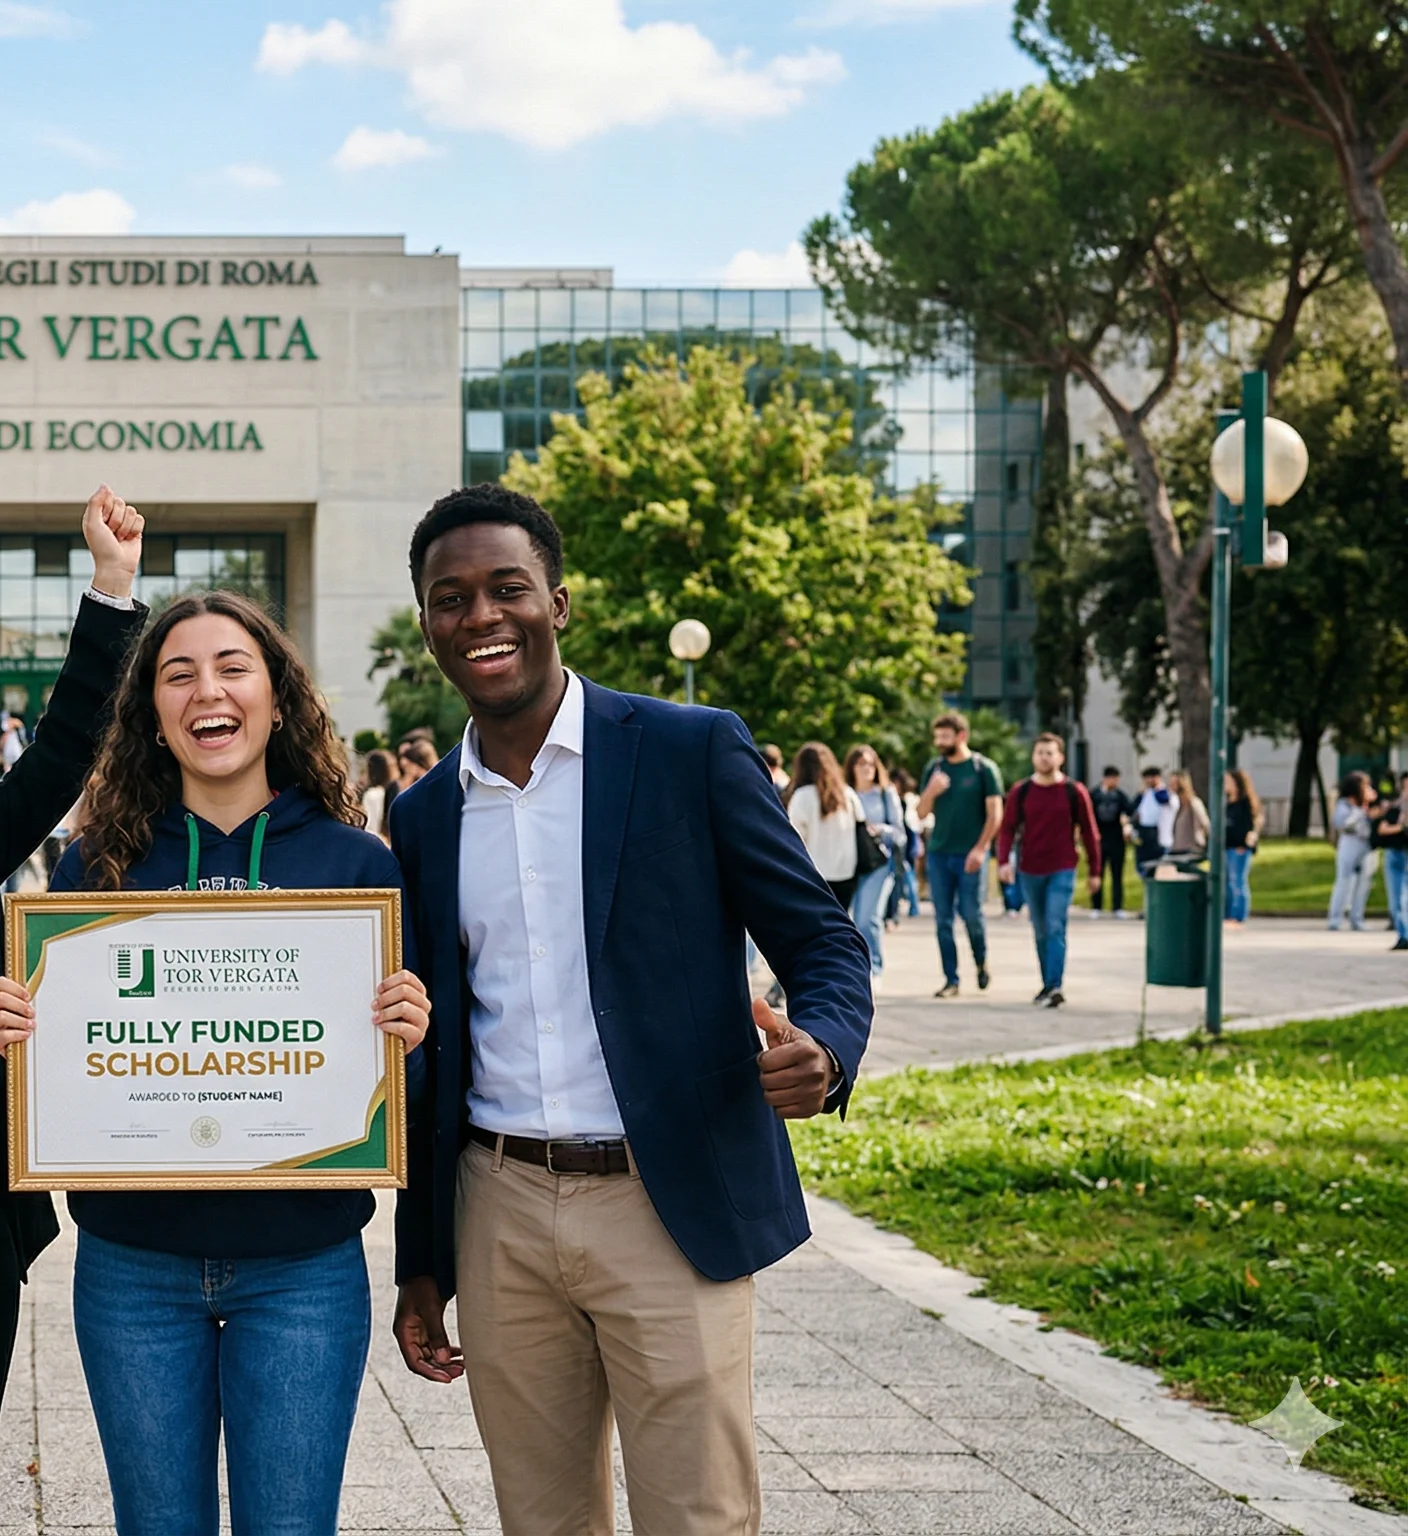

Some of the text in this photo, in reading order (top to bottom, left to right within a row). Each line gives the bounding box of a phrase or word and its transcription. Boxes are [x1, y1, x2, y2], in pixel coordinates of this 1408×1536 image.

[69, 260, 165, 286] STUDI
[176, 261, 209, 286] DI
[222, 261, 318, 286] ROMA
[42, 314, 319, 362] VERGATA
[46, 420, 264, 452] ECONOMIA
[163, 948, 300, 964] UNIVERSITY OF
[164, 967, 299, 984] TOR VERGATA
[87, 1020, 325, 1045] FULLY FUNDED
[86, 1050, 325, 1078] SCHOLARSHIP
[182, 1092, 196, 1101] TO
